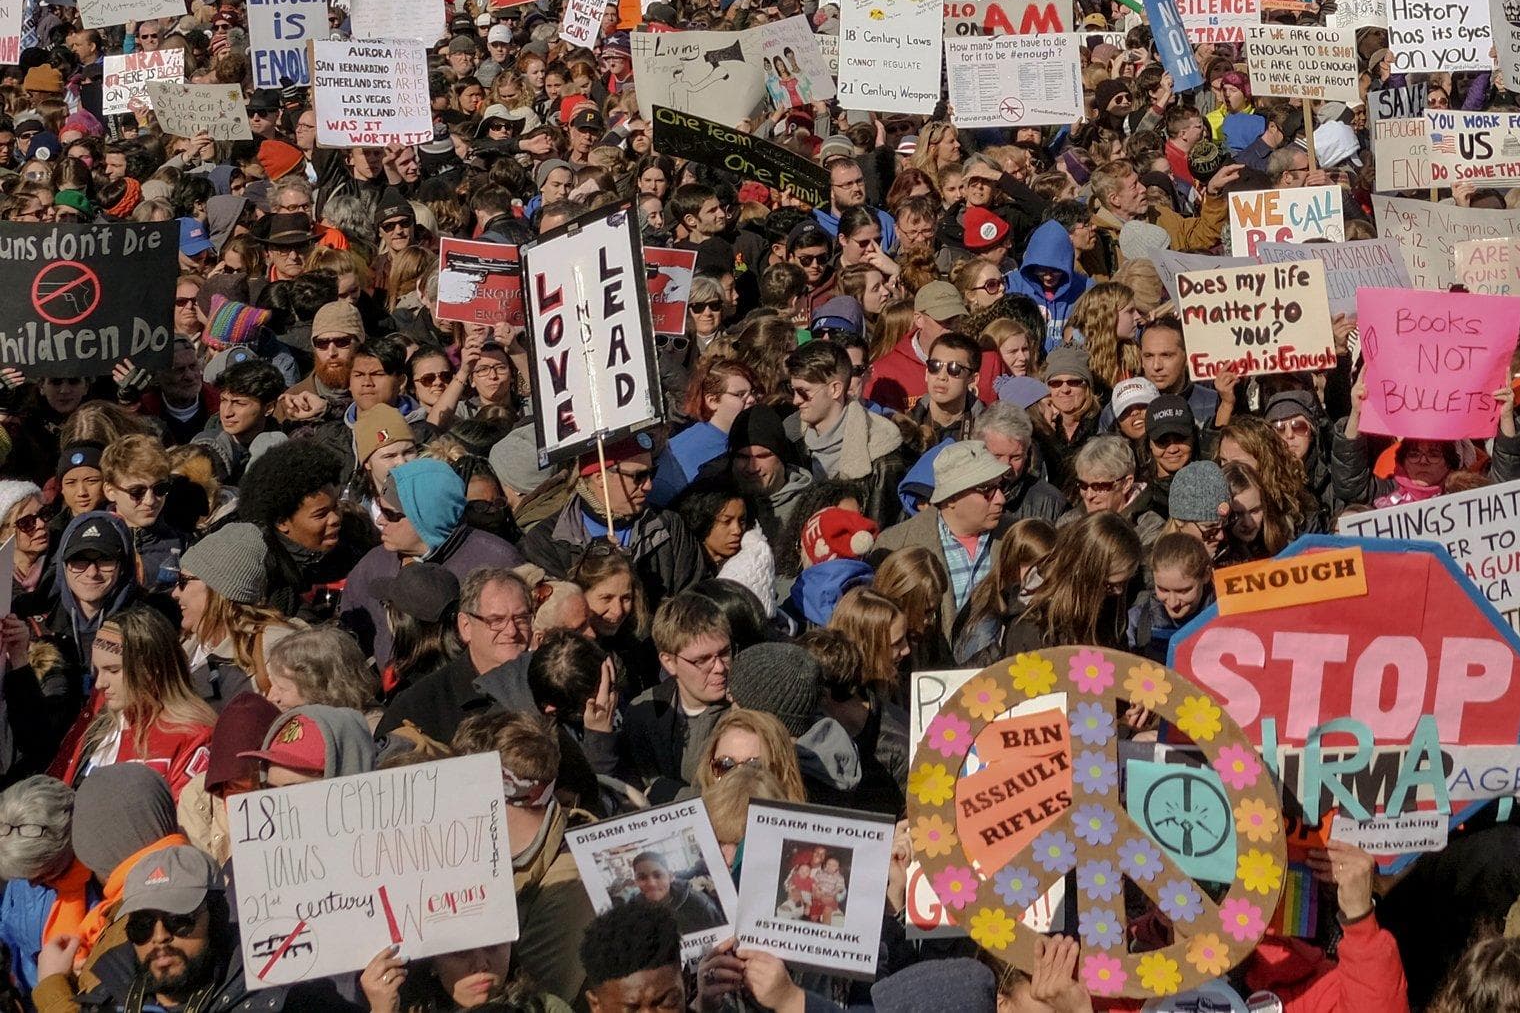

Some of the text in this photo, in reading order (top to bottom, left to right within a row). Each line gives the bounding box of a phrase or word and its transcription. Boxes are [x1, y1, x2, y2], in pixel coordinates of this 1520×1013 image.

[273, 11, 306, 40] is
[1392, 0, 1469, 24] History
[864, 30, 932, 48] Century Laws
[1249, 28, 1340, 42] IF WE ARE OLD
[1389, 24, 1491, 45] has its eyes
[124, 51, 165, 71] NRA
[861, 83, 938, 100] Century Weapons
[327, 120, 382, 131] WAS IT
[656, 107, 751, 148] One Team
[1428, 113, 1455, 130] YOU
[1463, 115, 1500, 128] WORK
[349, 131, 432, 144] WORTH IT?
[1459, 132, 1493, 160] US
[1232, 191, 1341, 235] WE CALL
[0, 226, 161, 261] uns don't Die
[1469, 245, 1509, 265] ARE
[1177, 265, 1310, 299] Does my life
[598, 246, 636, 408] LEAD
[1231, 320, 1284, 346] you?
[534, 272, 581, 442] LOVE
[1418, 344, 1488, 374] NOT
[1153, 409, 1174, 423] WOKE
[1481, 530, 1516, 552] TO
[1223, 556, 1358, 596] ENOUGH
[1190, 626, 1514, 745] STOP
[999, 723, 1064, 751] BAN
[959, 750, 1071, 819] ASSAULT
[237, 766, 442, 845] 18th century
[978, 788, 1074, 847] RIFLES
[576, 805, 698, 845] DISARM the POLICE
[756, 814, 886, 842] DISARM the POLICE
[1358, 817, 1439, 831] from taking
[263, 816, 489, 890] laws CANNOT
[1358, 837, 1440, 850] backwards.
[755, 920, 860, 943] #STEPHONCLARK
[739, 934, 873, 964] #BLACKLIVESMATTER
